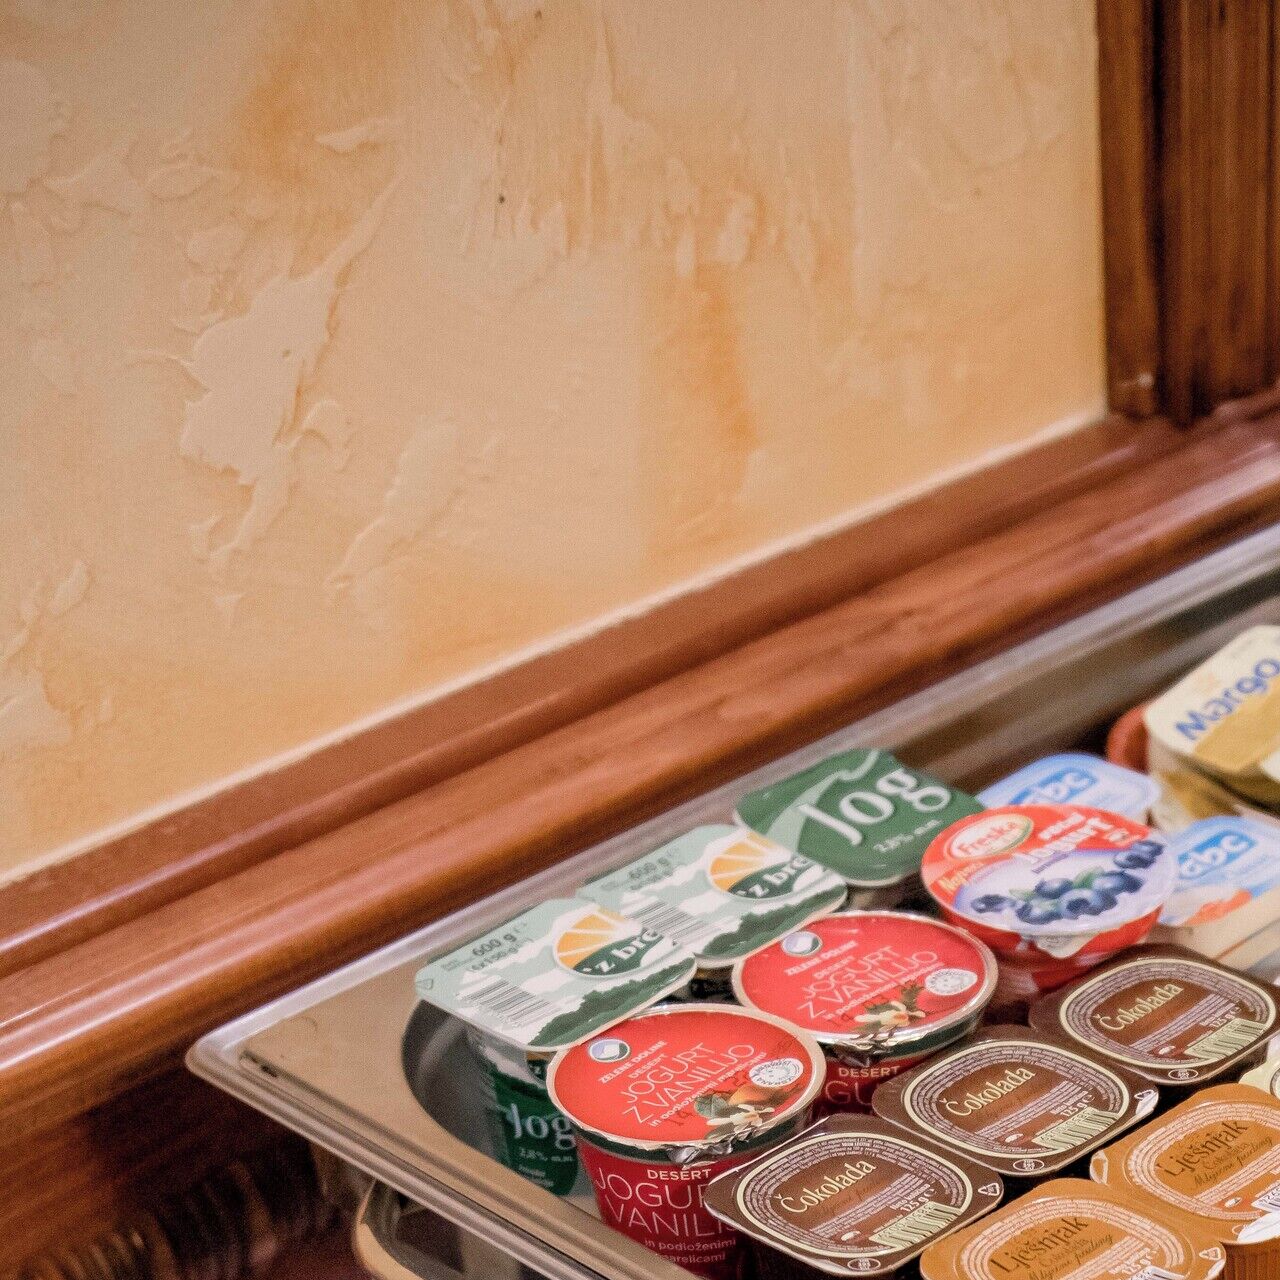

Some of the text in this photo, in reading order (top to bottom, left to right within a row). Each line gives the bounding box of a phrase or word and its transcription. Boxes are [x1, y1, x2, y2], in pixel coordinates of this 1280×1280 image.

[798, 768, 951, 847] Jog
[798, 1002, 827, 1020] Z
[823, 950, 938, 1004] VANILIJO
[801, 946, 894, 1000] JOGURT
[1092, 981, 1186, 1032] Čokolada
[598, 1040, 668, 1085] ZELENE DOLINE
[619, 1043, 714, 1104] JOGURT
[622, 1105, 655, 1126] Z
[643, 1043, 756, 1110] VANILIJO
[628, 1052, 669, 1080] DESERT
[838, 1066, 901, 1079] DESERT
[940, 1064, 1036, 1118] Čokolada
[511, 1103, 578, 1151] Jog
[1163, 1118, 1250, 1178] Lješnjak
[646, 1168, 712, 1182] DESERT
[777, 1157, 878, 1214] Čokolada
[989, 1214, 1090, 1275] Lješnjak
